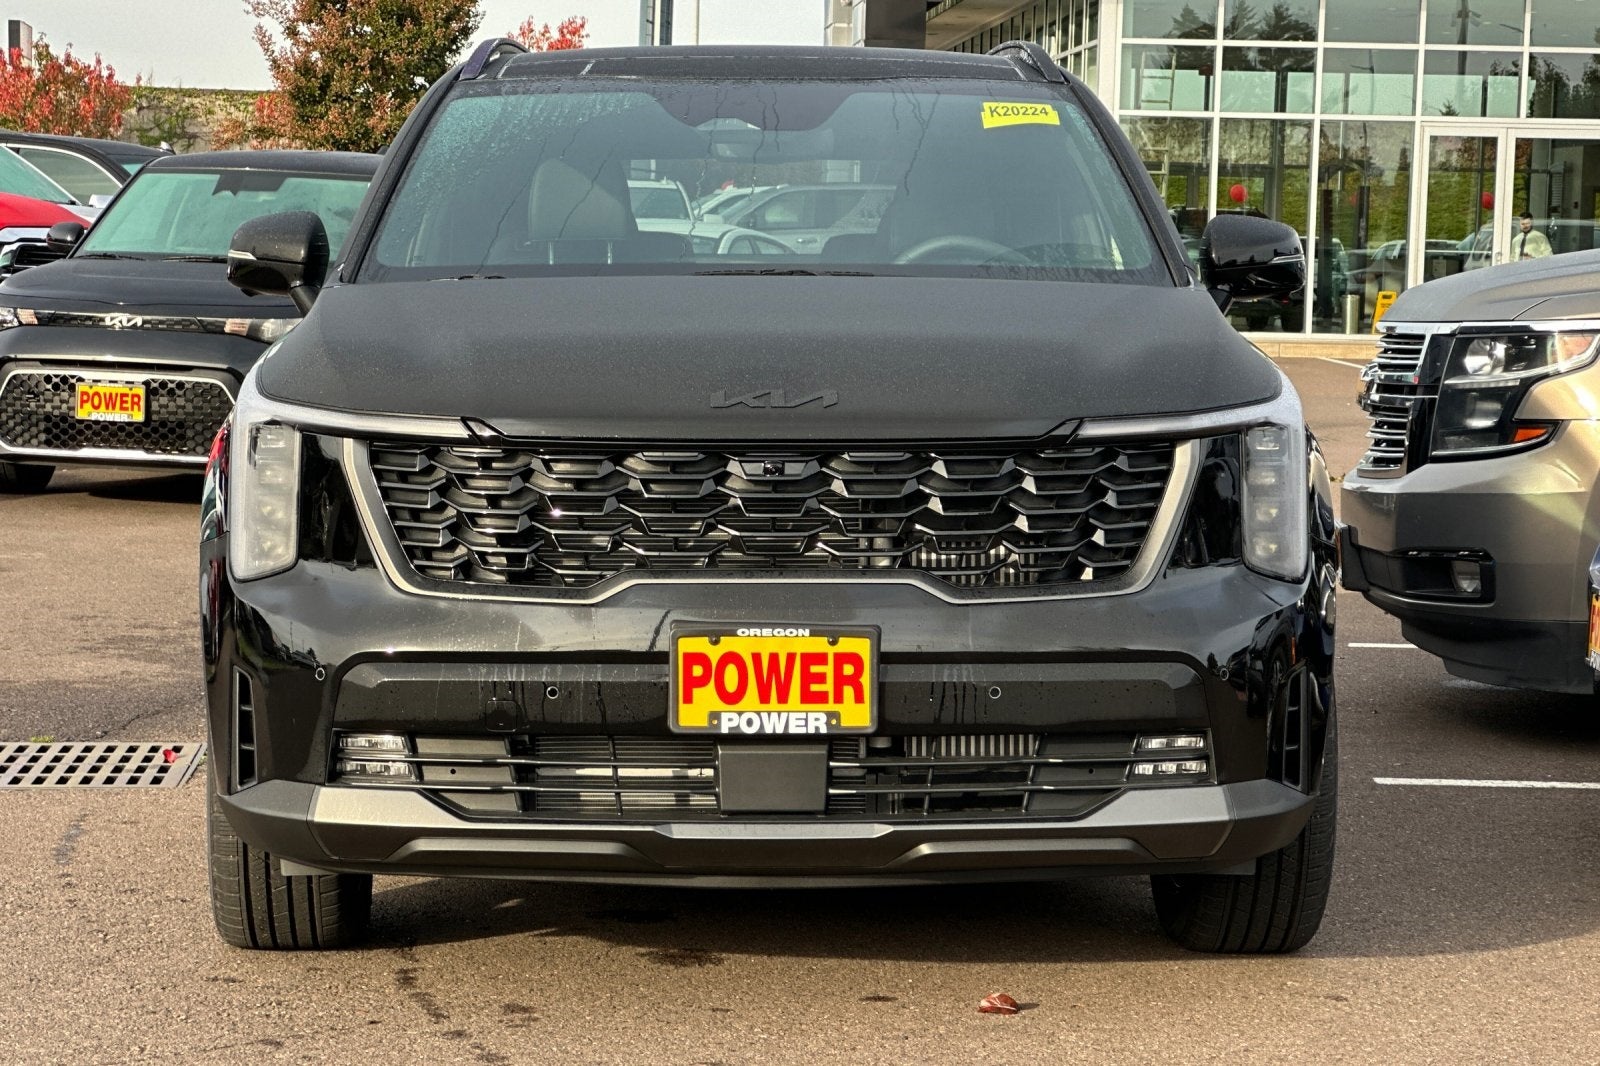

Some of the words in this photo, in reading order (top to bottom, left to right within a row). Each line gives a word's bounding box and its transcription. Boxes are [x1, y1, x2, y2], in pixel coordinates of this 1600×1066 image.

[989, 105, 1049, 118] K20224
[79, 390, 142, 413] POWER
[710, 389, 839, 409] KIA
[91, 411, 128, 422] POWER
[736, 628, 810, 637] OREGON
[682, 650, 866, 705] POWER
[720, 711, 828, 734] POWER
